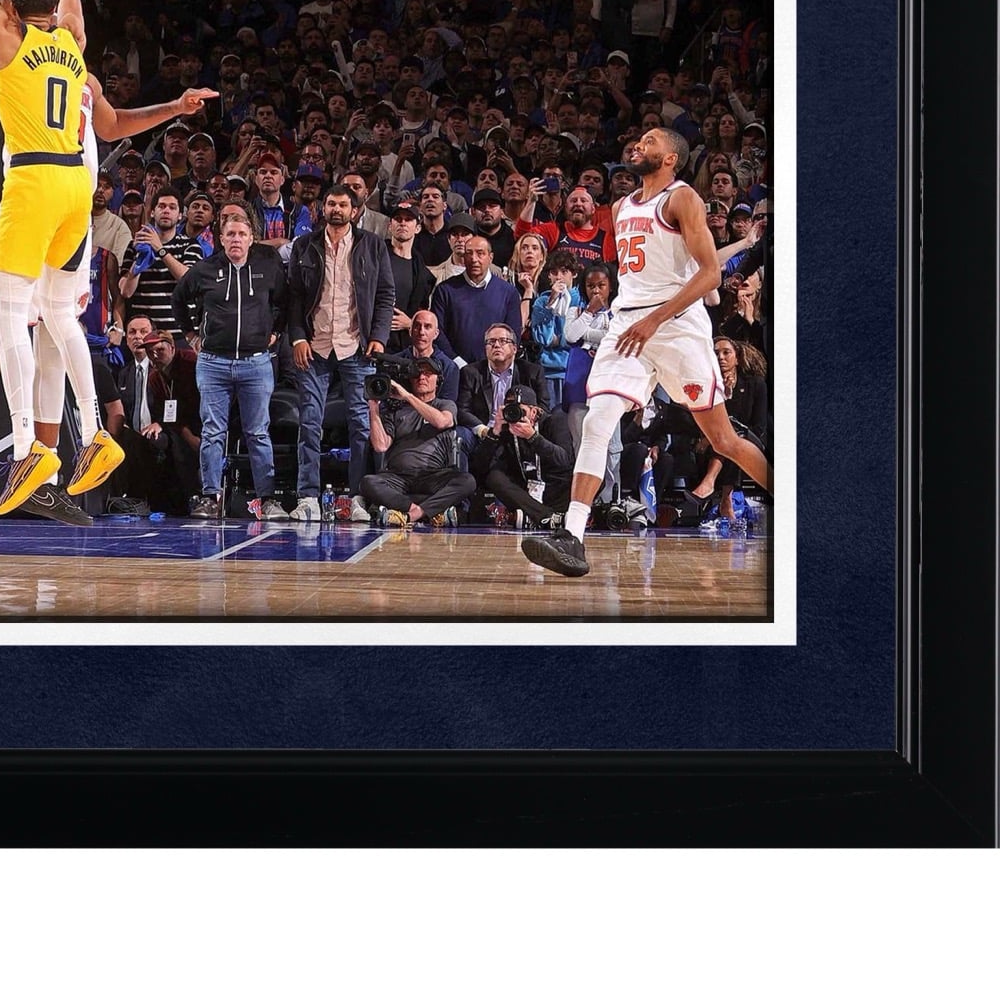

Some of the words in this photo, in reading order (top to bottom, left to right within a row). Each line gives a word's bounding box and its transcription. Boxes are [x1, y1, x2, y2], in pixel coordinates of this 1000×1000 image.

[22, 45, 84, 79] HALIBURTON
[46, 76, 68, 130] 0
[617, 236, 646, 276] 25
